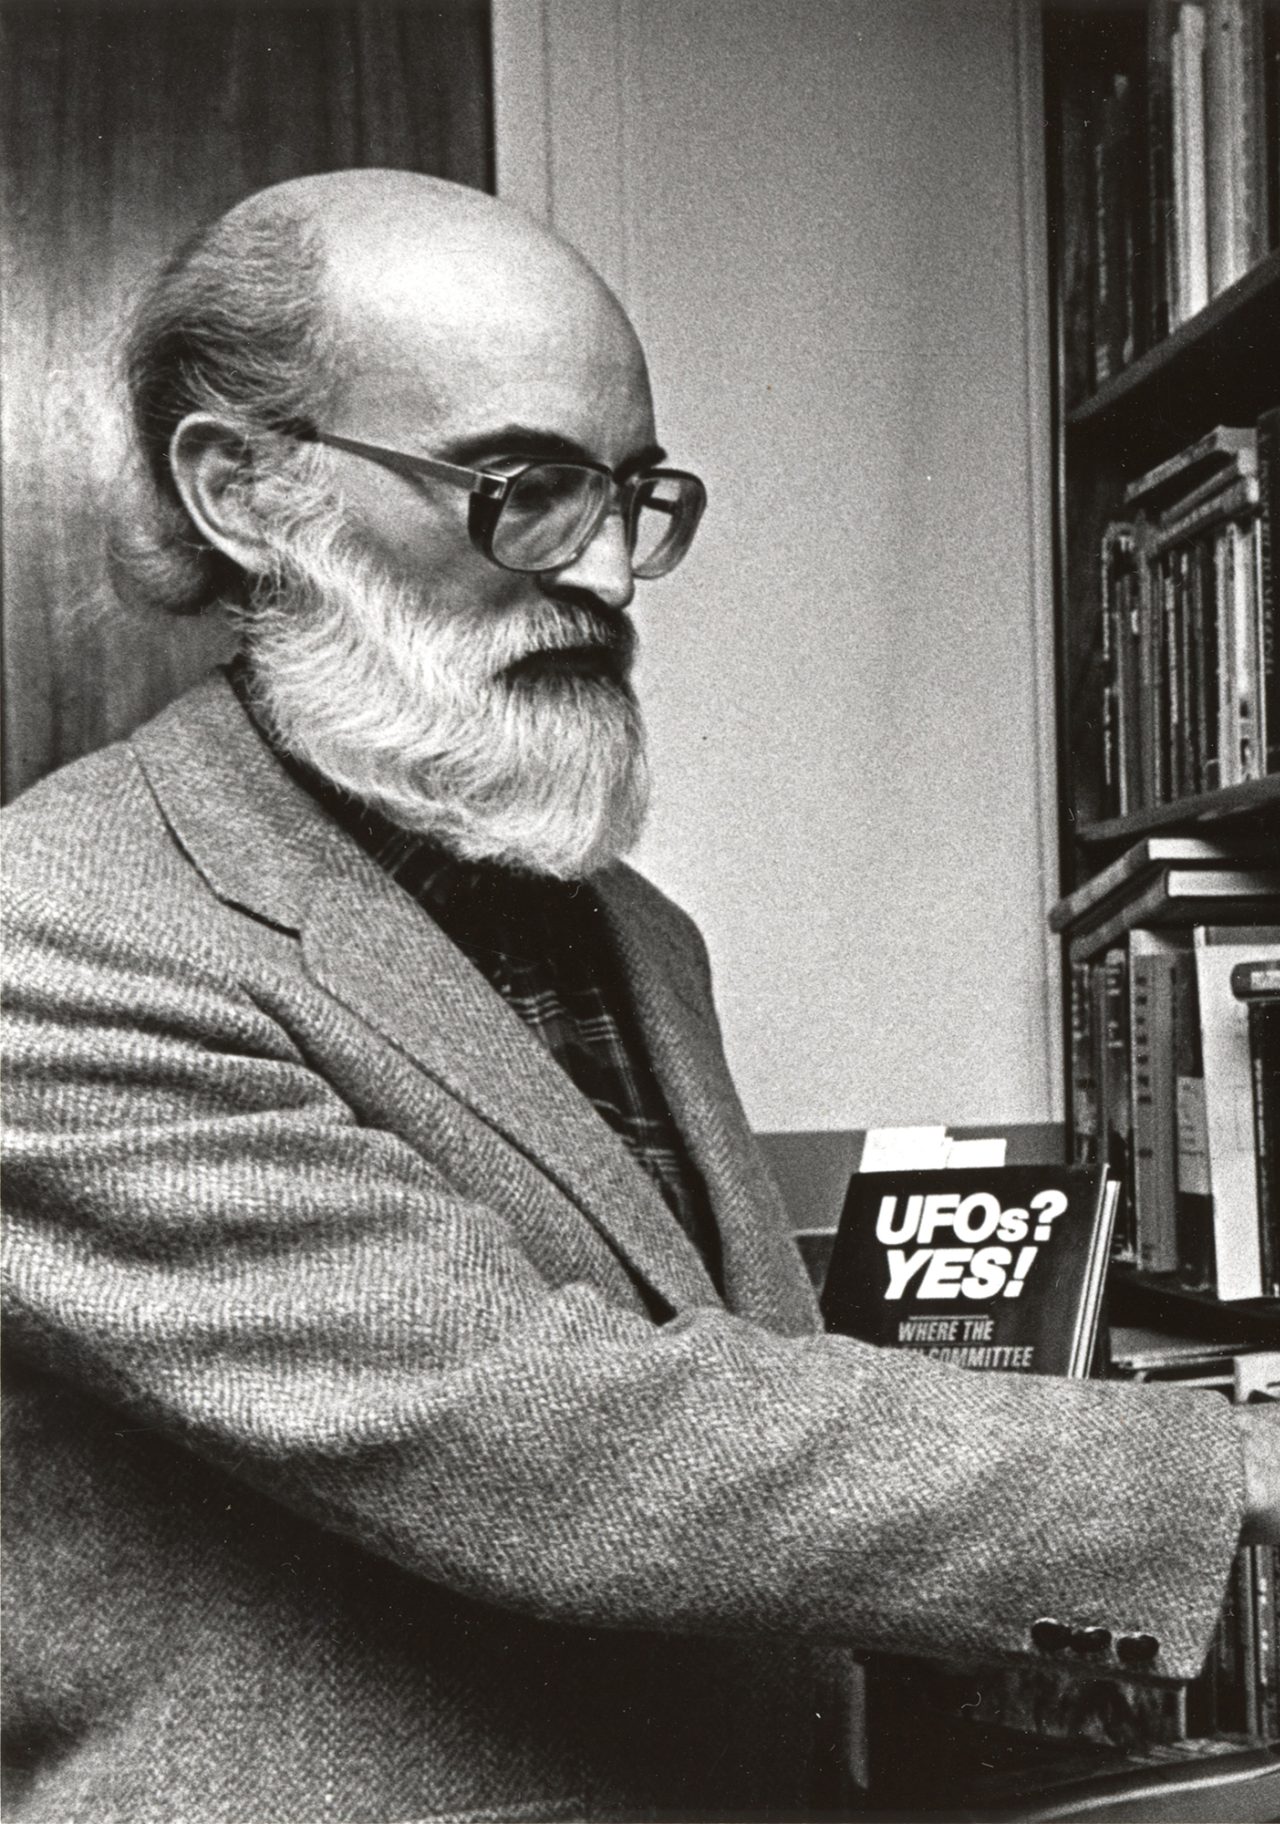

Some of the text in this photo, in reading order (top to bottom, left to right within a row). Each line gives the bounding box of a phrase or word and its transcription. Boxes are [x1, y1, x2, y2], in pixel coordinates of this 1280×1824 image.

[875, 1188, 1069, 1246] UFOs?
[883, 1246, 1039, 1300] YES!
[898, 1319, 995, 1342] WHERE THE
